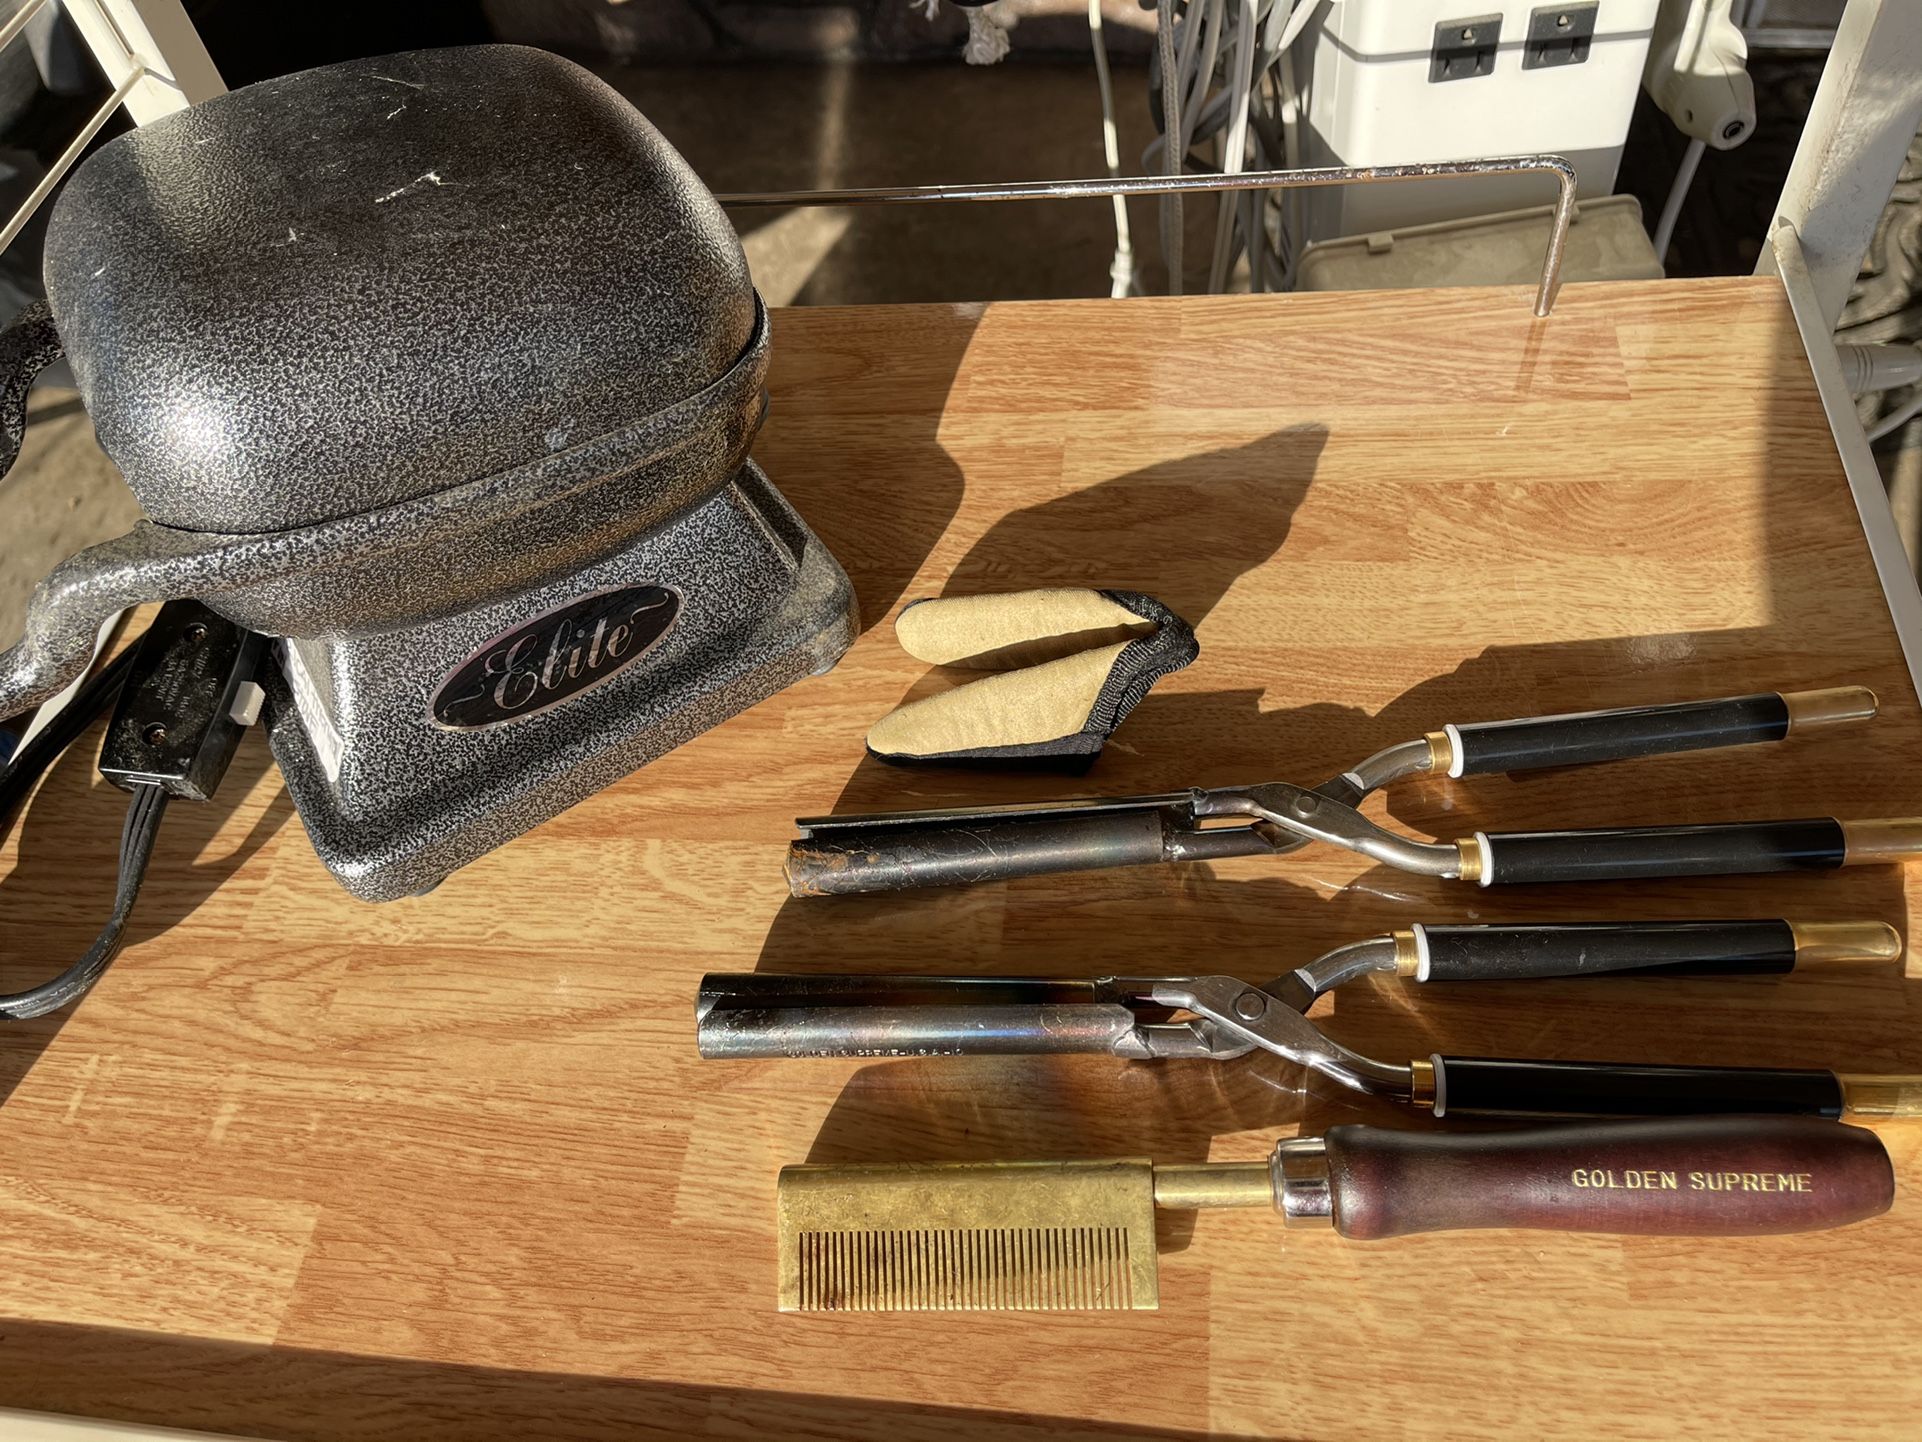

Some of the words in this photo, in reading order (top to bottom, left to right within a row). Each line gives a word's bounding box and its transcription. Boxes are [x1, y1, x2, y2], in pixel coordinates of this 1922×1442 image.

[484, 618, 634, 710] Elite
[1571, 1168, 1677, 1190] GOLDEN
[1688, 1171, 1813, 1193] SUPREME
